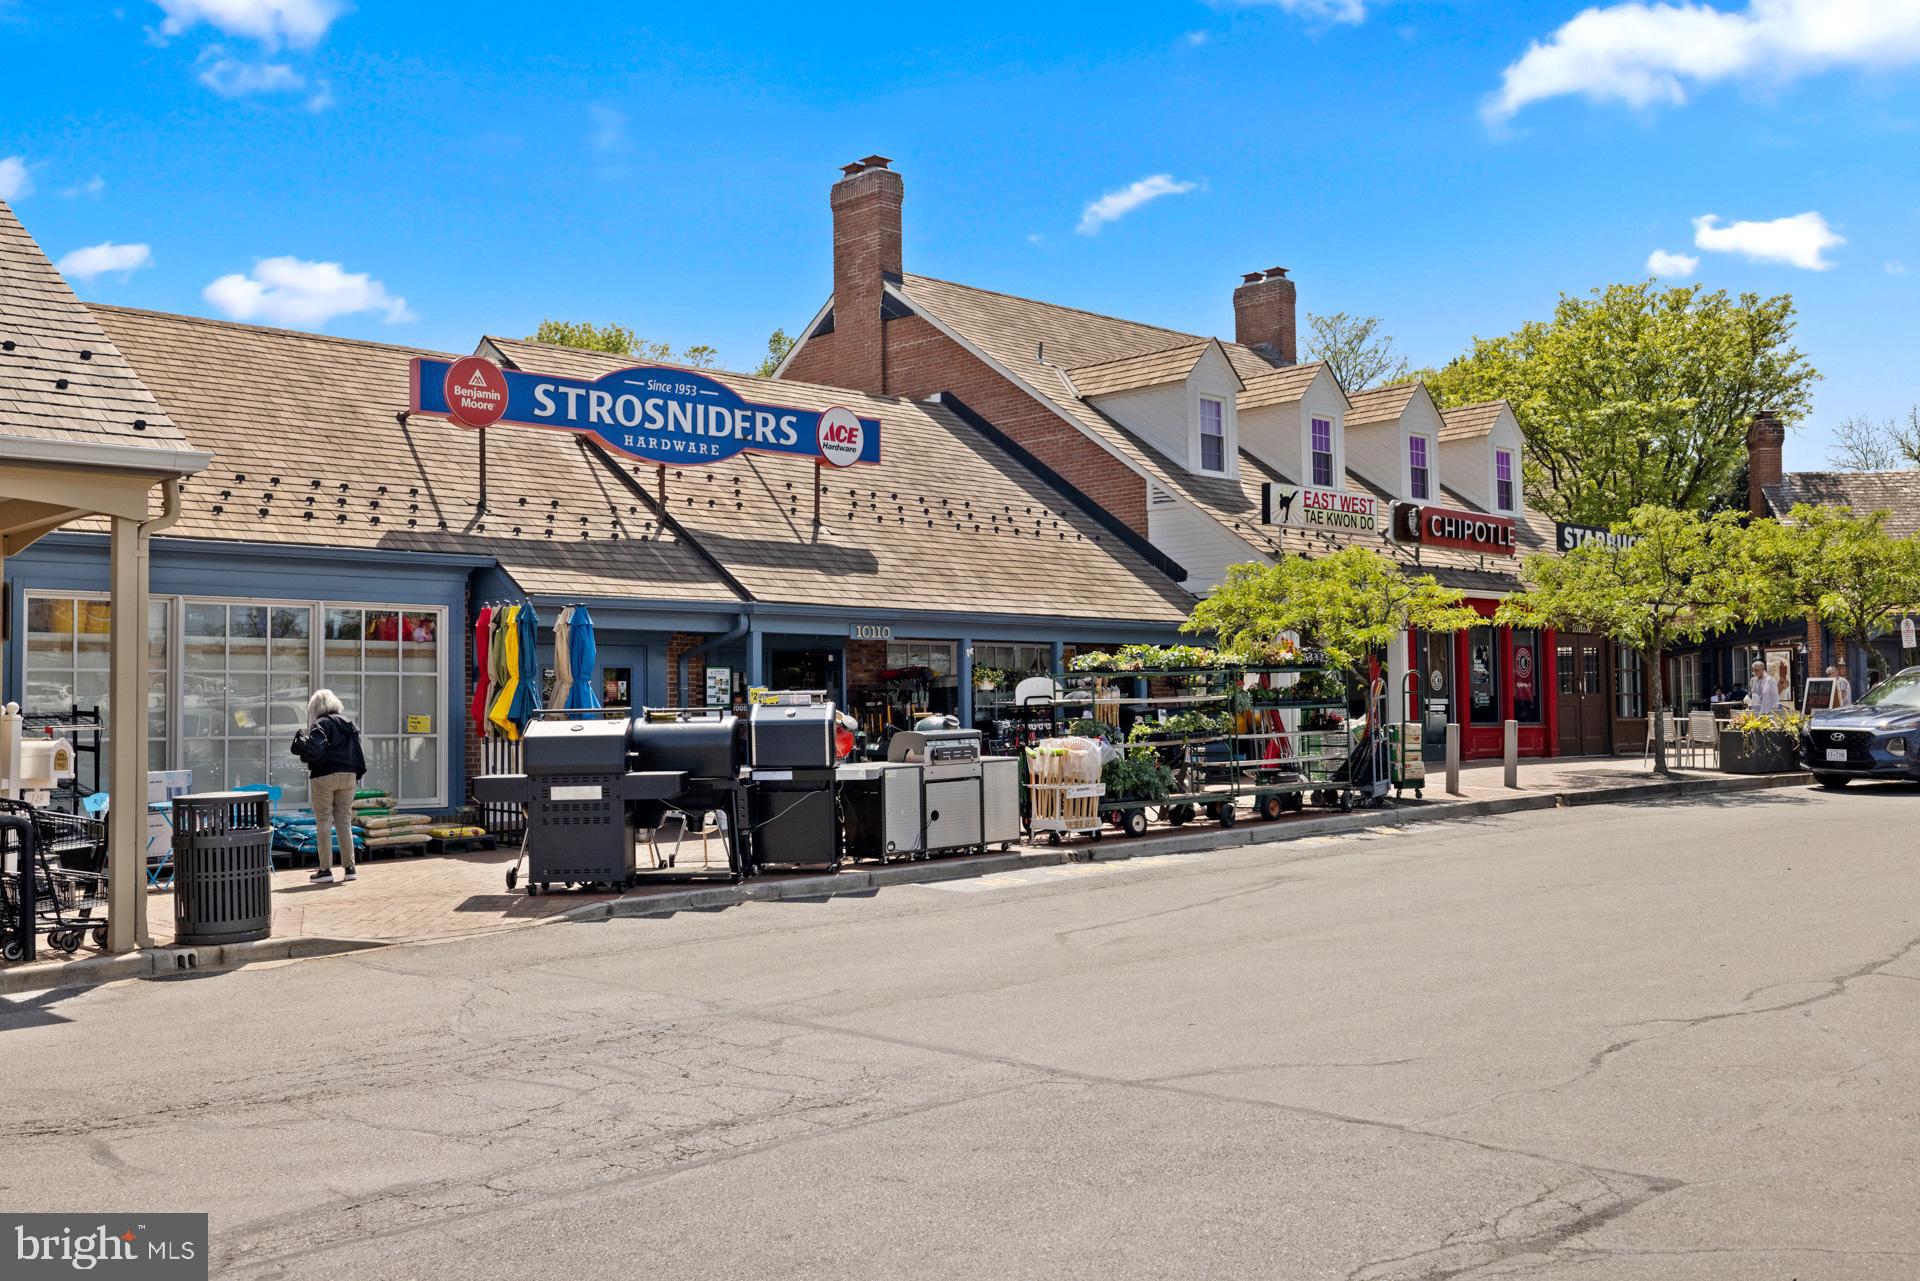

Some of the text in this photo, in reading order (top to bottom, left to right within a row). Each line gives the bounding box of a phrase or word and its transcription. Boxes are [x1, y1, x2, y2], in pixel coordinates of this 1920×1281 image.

[454, 385, 501, 401] Benjamin
[647, 380, 697, 396] Since 1953
[461, 398, 494, 411] Moore
[533, 383, 798, 446] STROSNIDERS
[823, 421, 859, 444] ACE
[624, 434, 720, 456] HARDWARE
[823, 442, 857, 454] Hardware
[1303, 491, 1375, 514] EAST WEST
[1304, 510, 1375, 530] TAE KWON DO
[1431, 515, 1516, 546] CHIPOTLE
[856, 626, 891, 638] 10110
